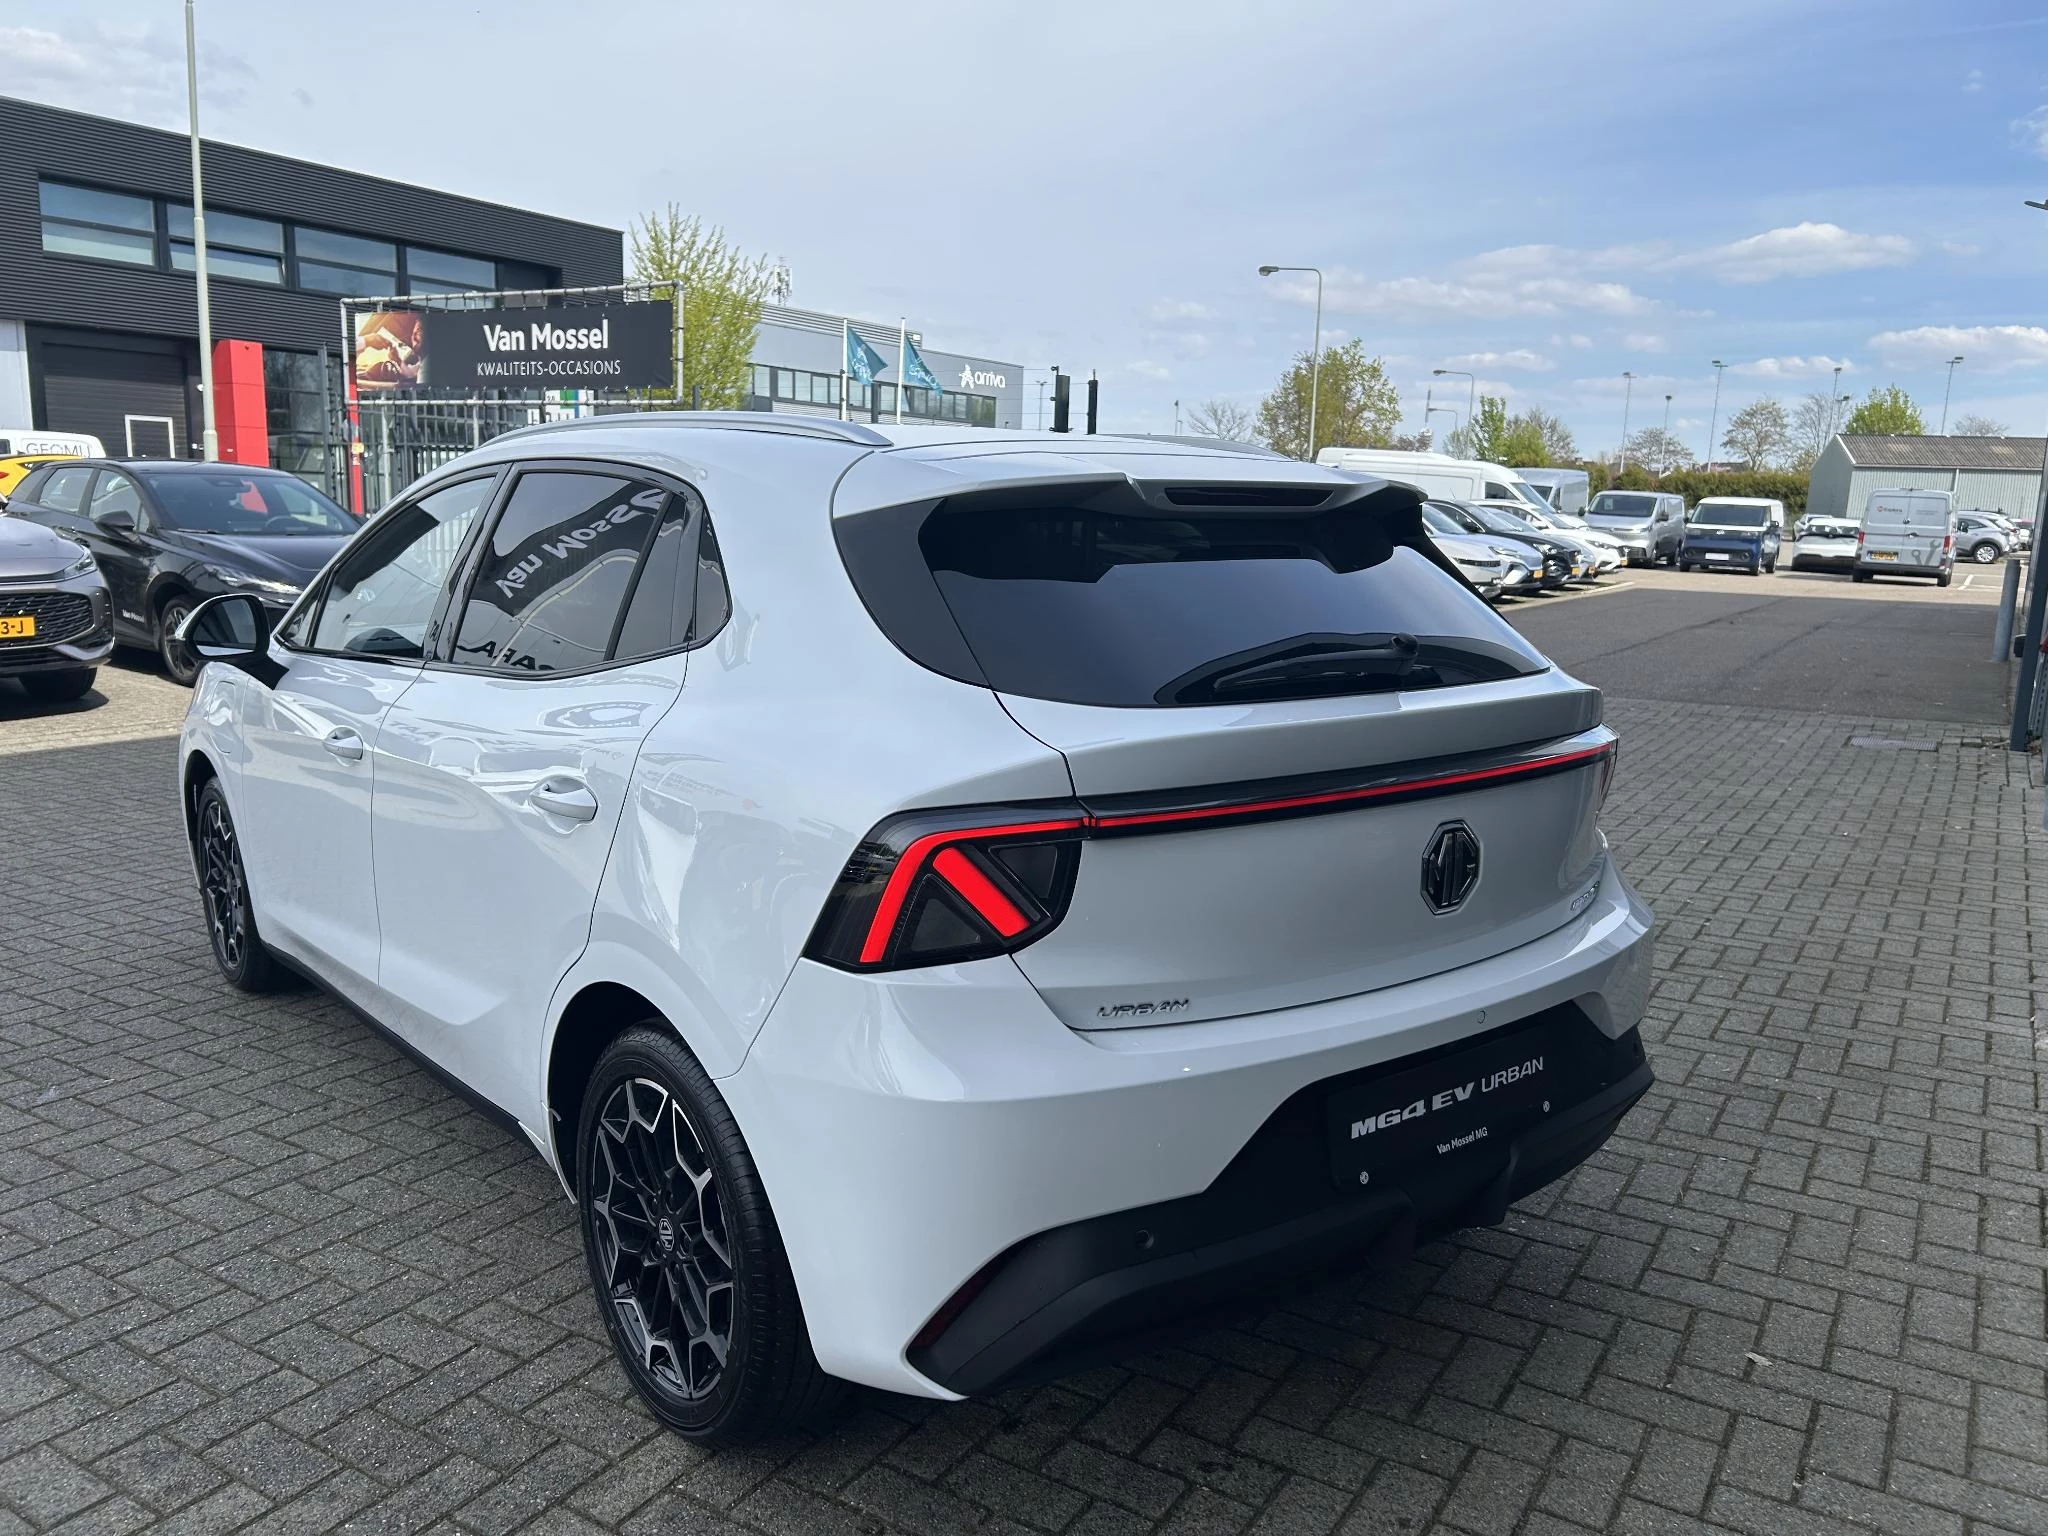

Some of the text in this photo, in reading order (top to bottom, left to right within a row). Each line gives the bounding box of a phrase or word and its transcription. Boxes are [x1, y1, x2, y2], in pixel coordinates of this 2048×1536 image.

[483, 319, 609, 351] Van Mossel
[477, 359, 621, 376] KWALITEITS-OCCASIONS
[974, 371, 1006, 388] arriva
[1097, 998, 1190, 1017] URBAN
[1351, 1056, 1544, 1139] MG4 EV URBAN
[1437, 1126, 1488, 1154] Van Mossel MG
